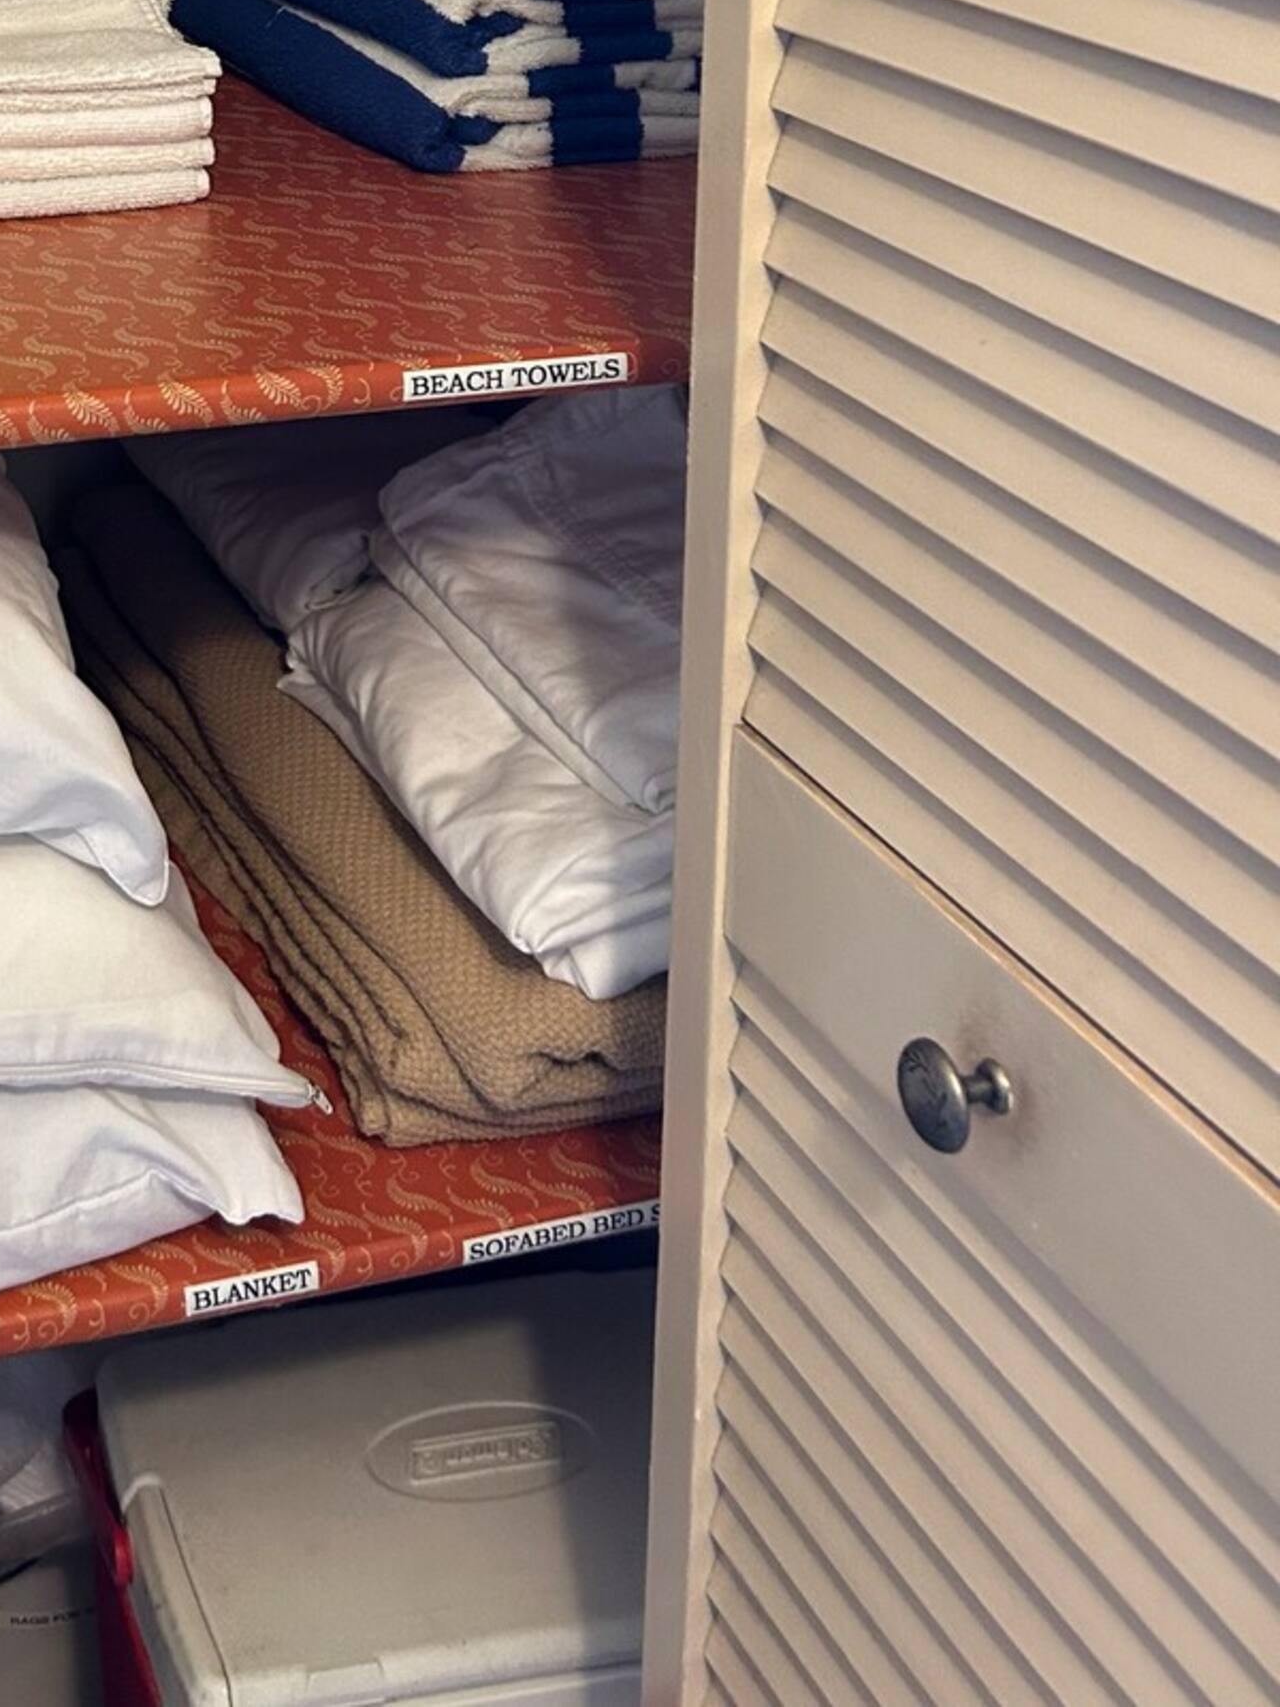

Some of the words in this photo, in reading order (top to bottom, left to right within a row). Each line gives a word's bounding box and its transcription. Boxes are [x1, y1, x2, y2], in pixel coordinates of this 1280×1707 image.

[411, 369, 504, 397] BEACH
[512, 359, 620, 388] TOWELS
[470, 1220, 587, 1261] SOFABED
[593, 1208, 646, 1234] BED
[193, 1268, 312, 1311] BLANKET
